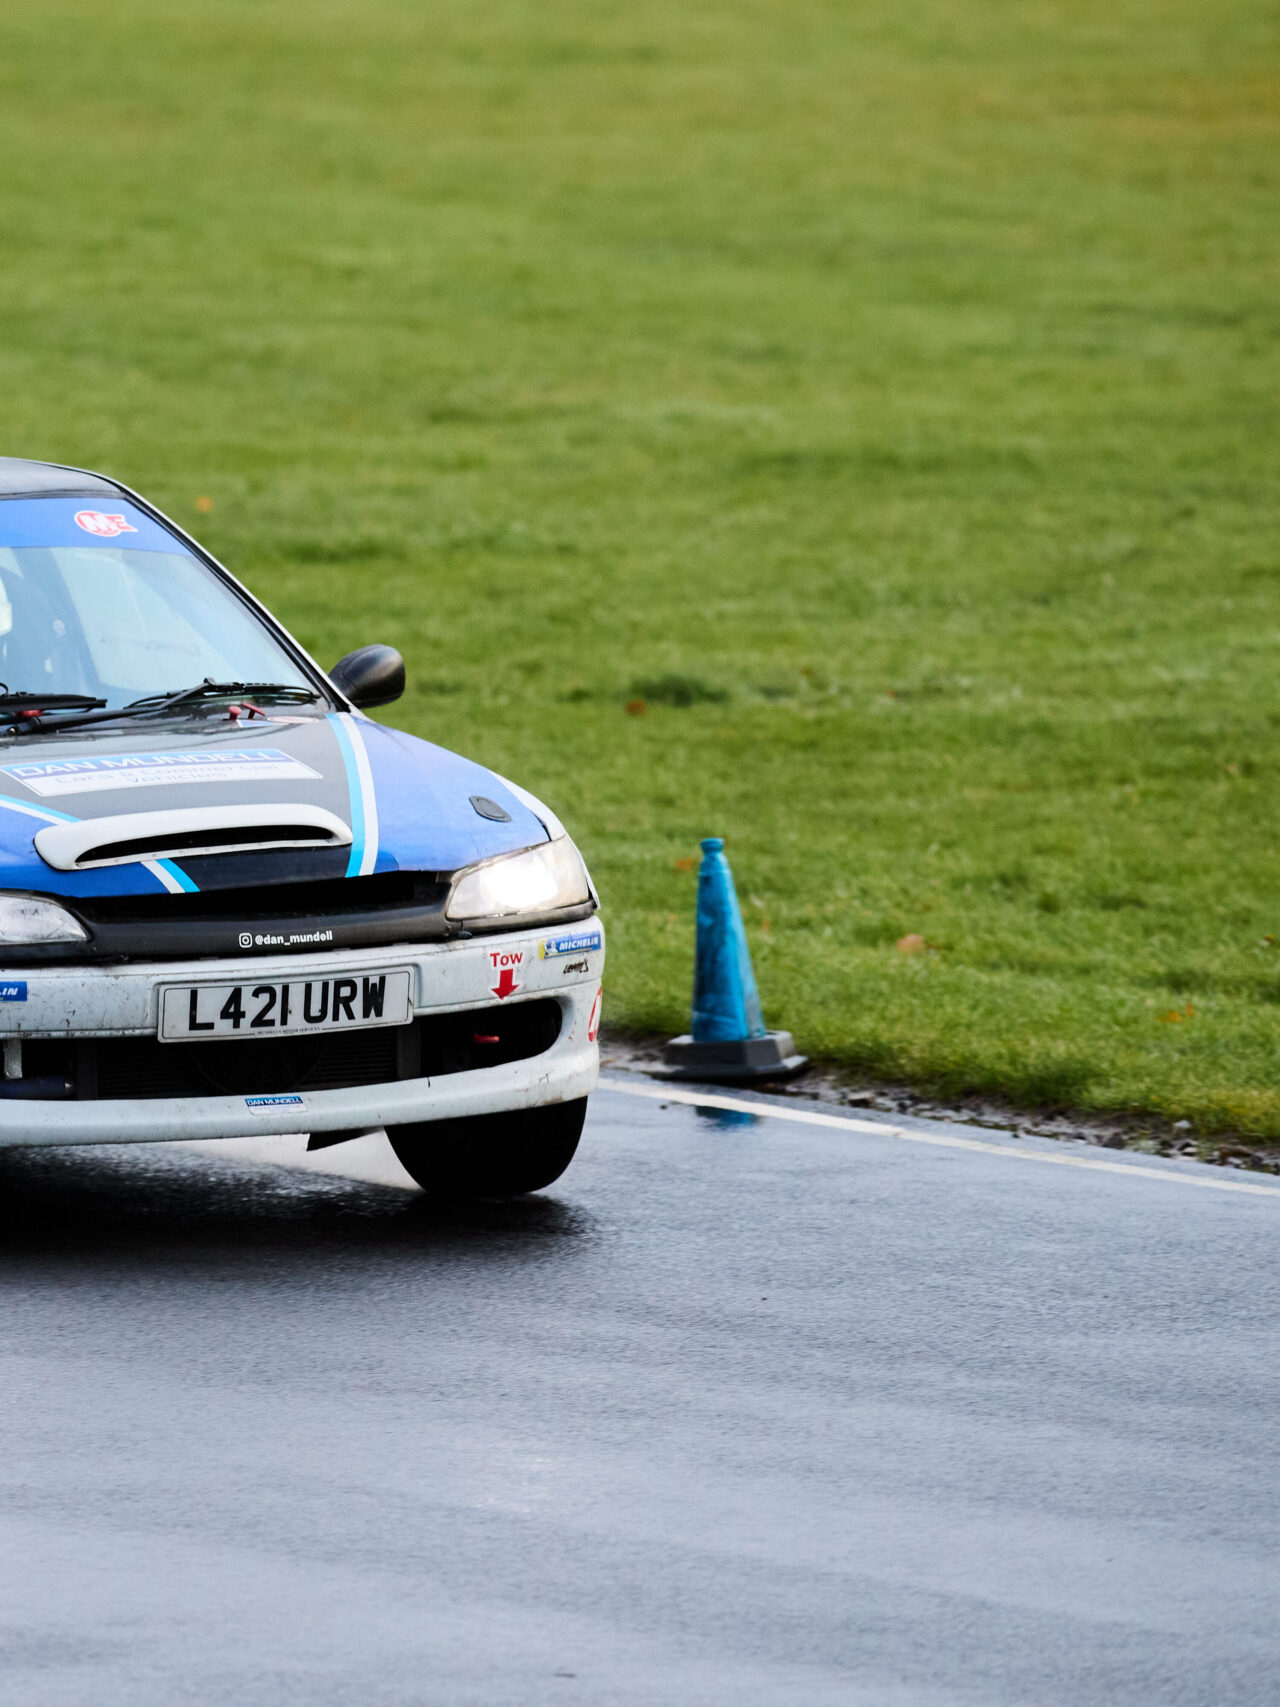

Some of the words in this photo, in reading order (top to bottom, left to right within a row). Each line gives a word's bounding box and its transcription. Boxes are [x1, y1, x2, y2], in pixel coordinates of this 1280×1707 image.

[12, 761, 99, 777] DAN
[106, 751, 287, 769] MUNDELL
[255, 930, 333, 945] @dan_mundell
[559, 936, 599, 951] MICHELIN
[188, 984, 289, 1031] L421
[303, 975, 386, 1024] URW
[264, 1097, 302, 1105] MUNDELL
